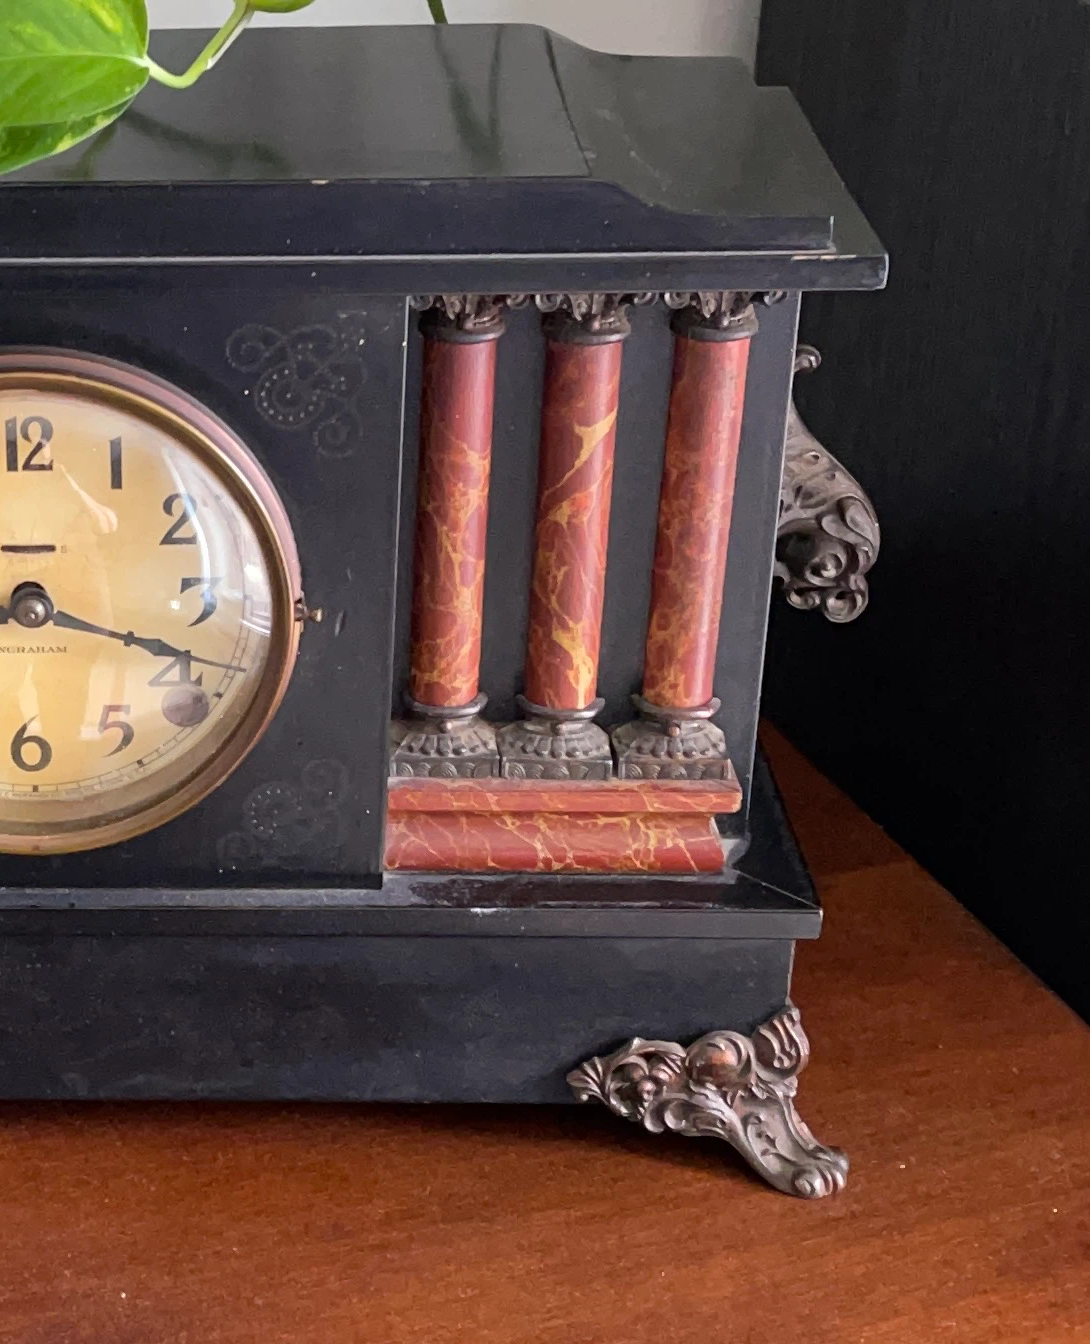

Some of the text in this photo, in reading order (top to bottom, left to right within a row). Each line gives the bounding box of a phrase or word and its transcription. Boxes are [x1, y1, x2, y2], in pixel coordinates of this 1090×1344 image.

[5, 416, 54, 472] 12
[109, 436, 123, 489] 1
[159, 493, 198, 545] 2
[180, 577, 223, 627] 3
[10, 714, 53, 773] 6
[98, 704, 135, 758] 5
